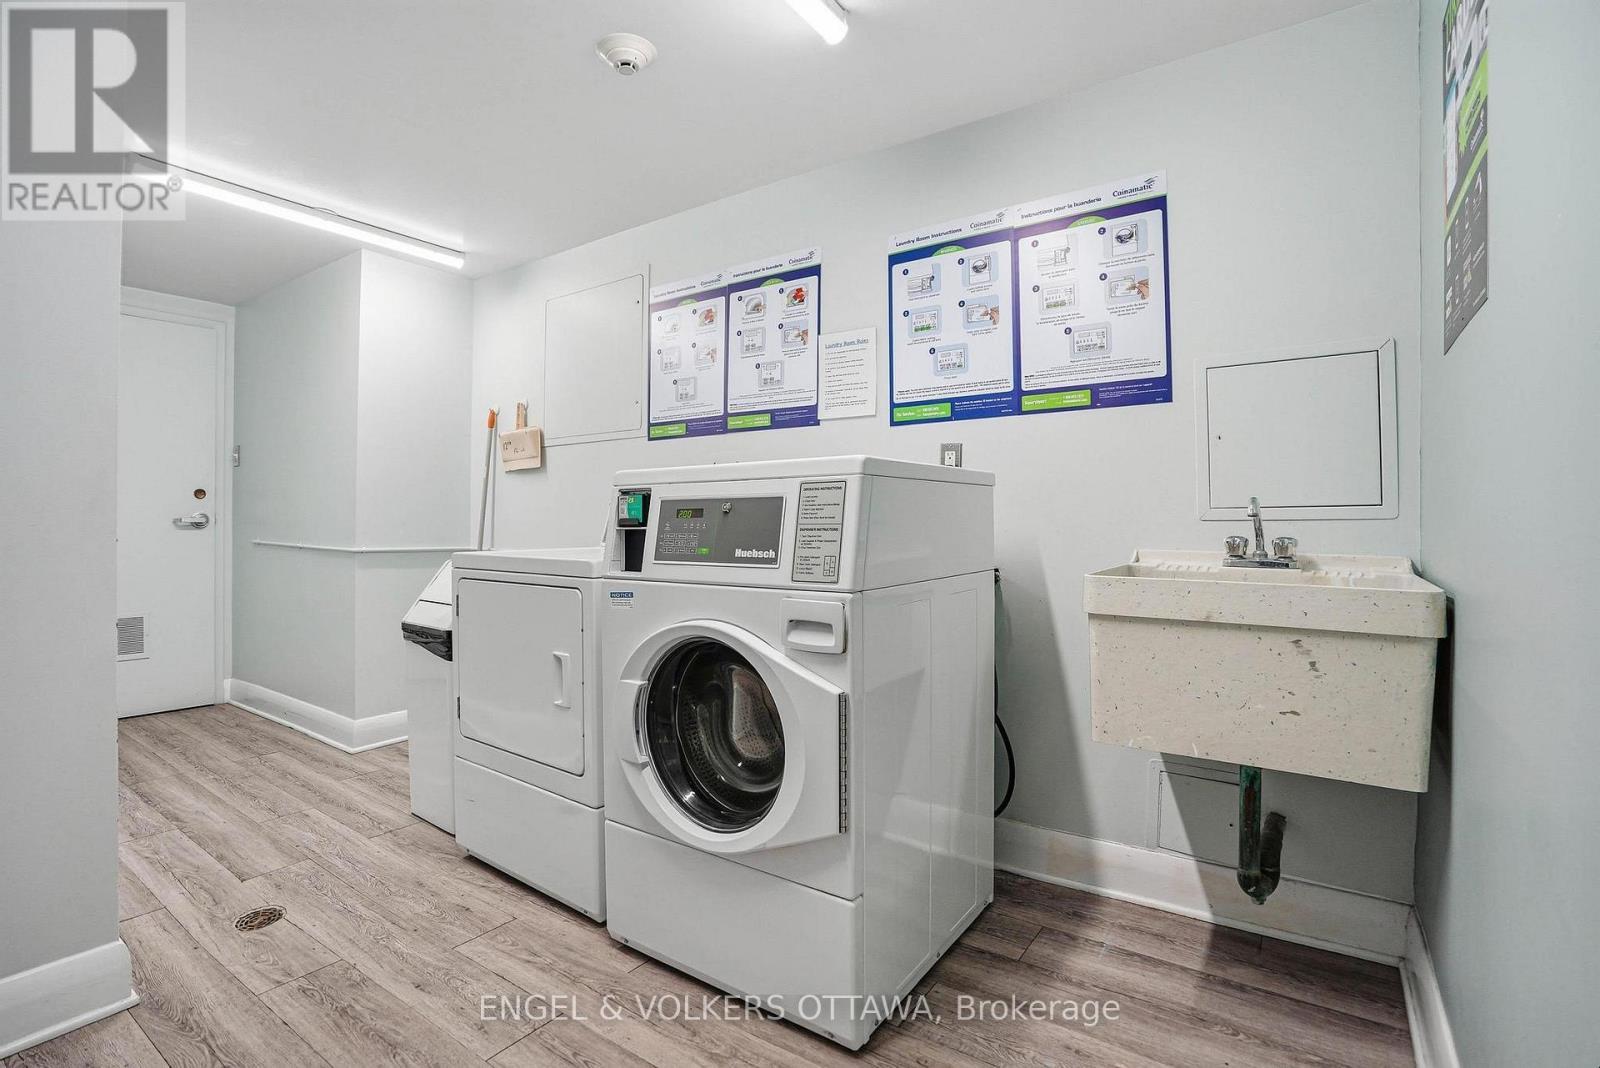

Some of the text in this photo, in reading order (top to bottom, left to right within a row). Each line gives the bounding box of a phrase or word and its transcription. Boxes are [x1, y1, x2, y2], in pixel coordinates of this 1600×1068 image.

[1112, 183, 1153, 198] Coinamatic
[1020, 209, 1053, 219] Instructions
[1053, 205, 1066, 213] pour
[1073, 197, 1102, 208] buanderie
[969, 217, 1004, 230] Coinamatic
[931, 227, 962, 239] Instructions
[735, 549, 775, 559] Huebsch
